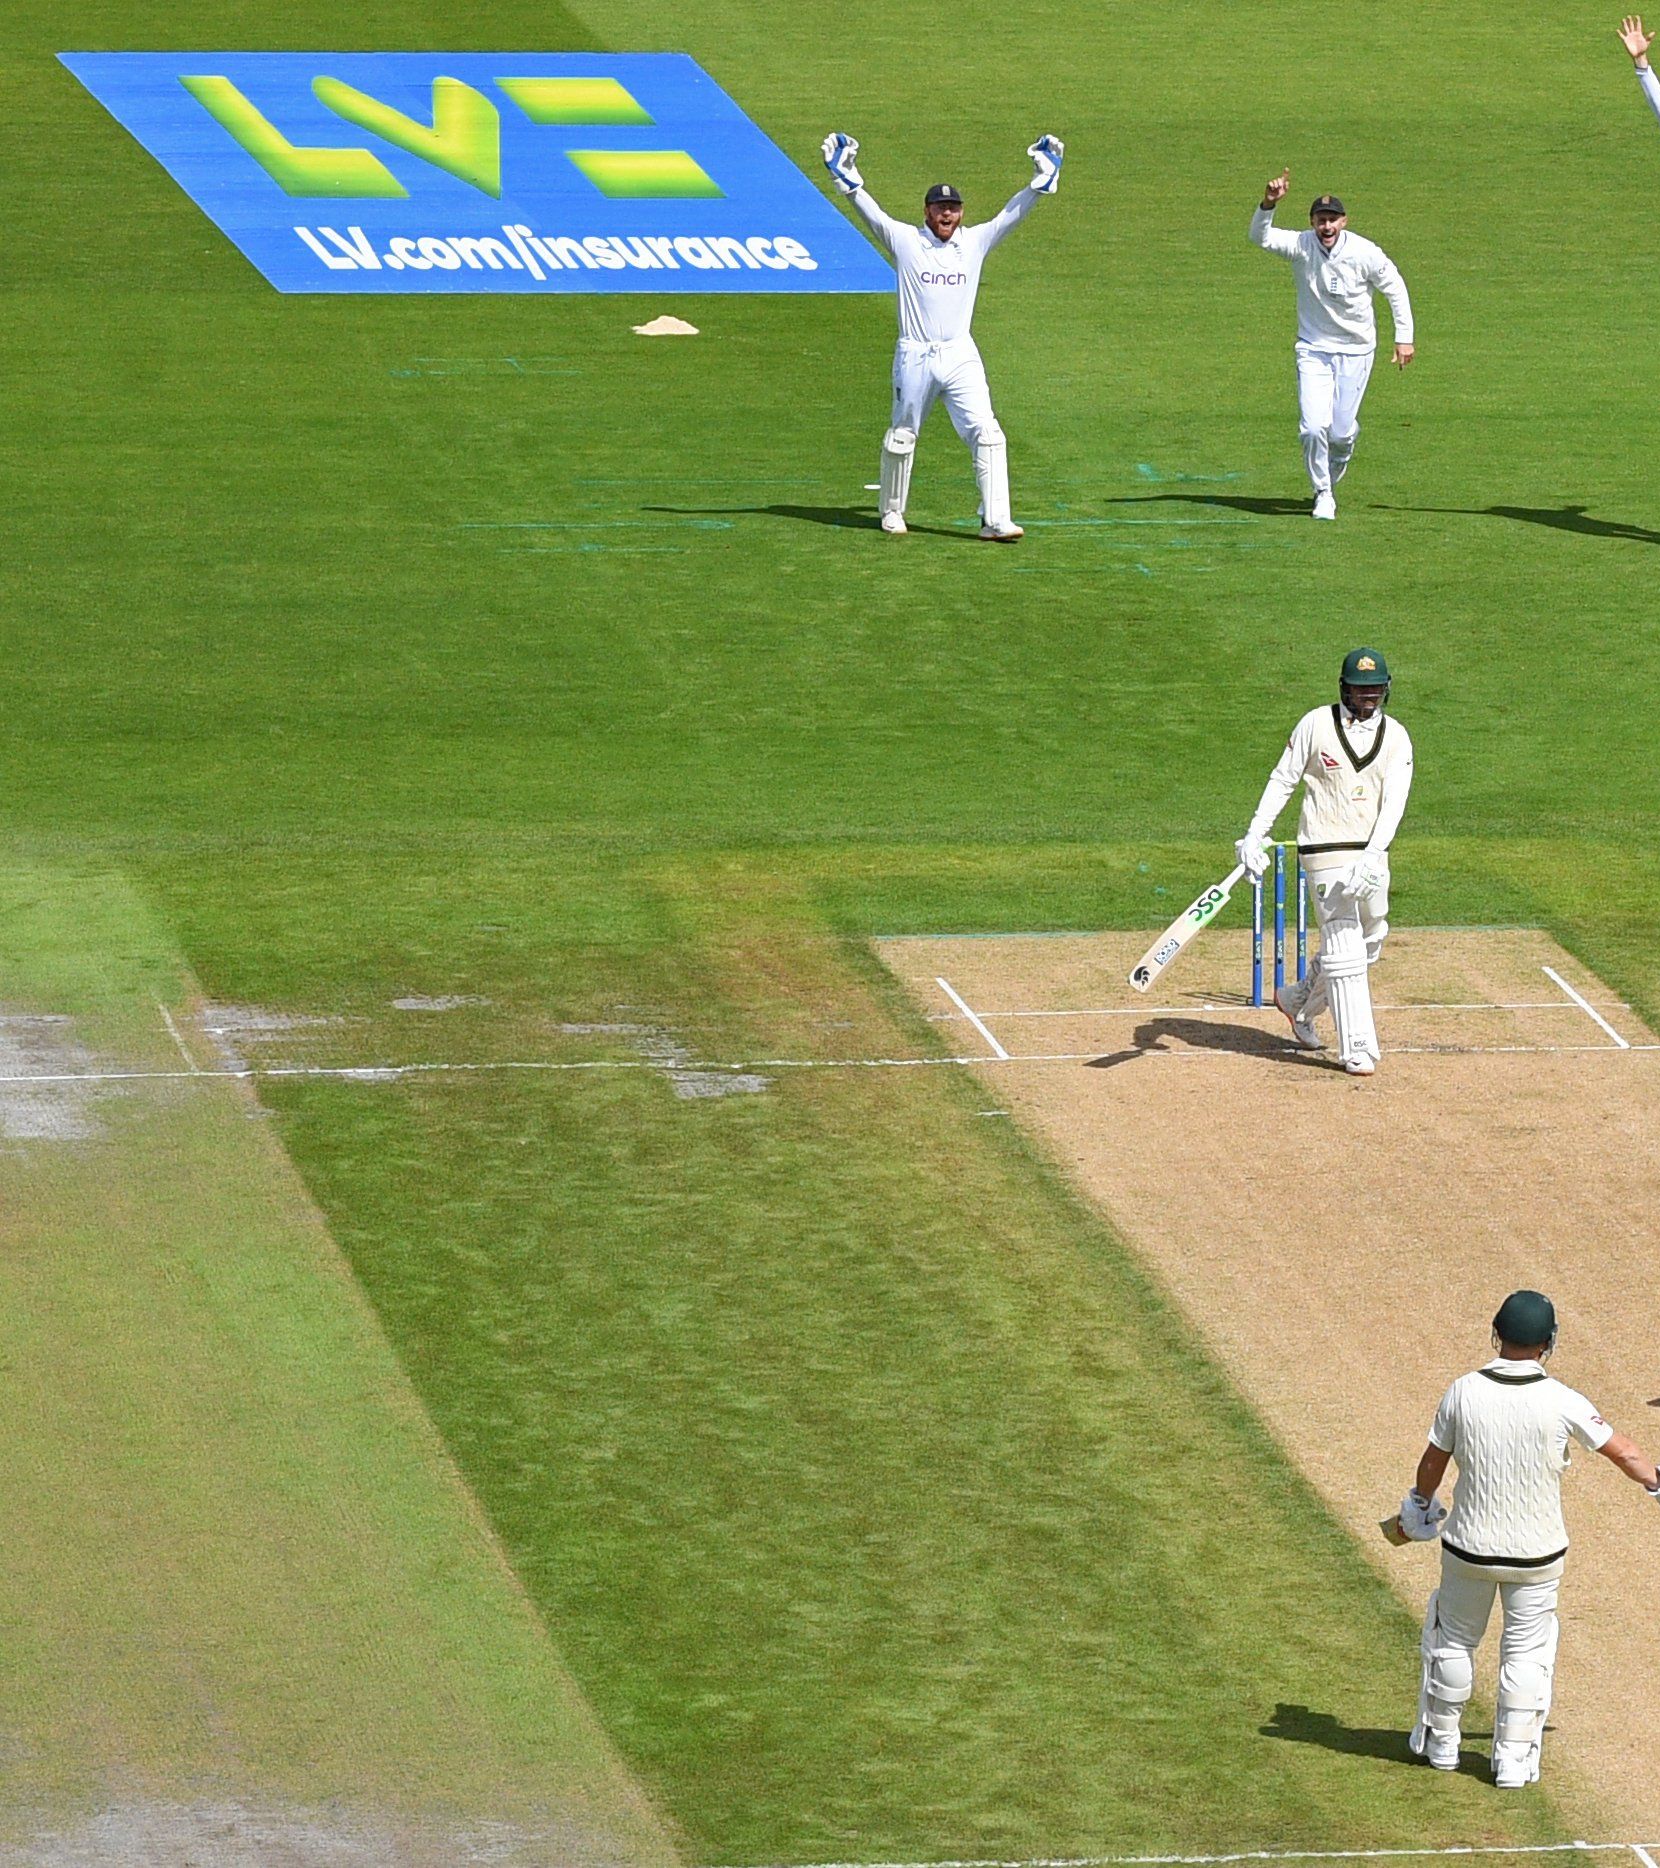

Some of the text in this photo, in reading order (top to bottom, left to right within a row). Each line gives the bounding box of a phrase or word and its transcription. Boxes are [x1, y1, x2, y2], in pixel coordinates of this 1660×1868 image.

[294, 224, 818, 280] LV.com/insurance
[920, 271, 967, 285] cinch
[1188, 888, 1224, 921] DSC
